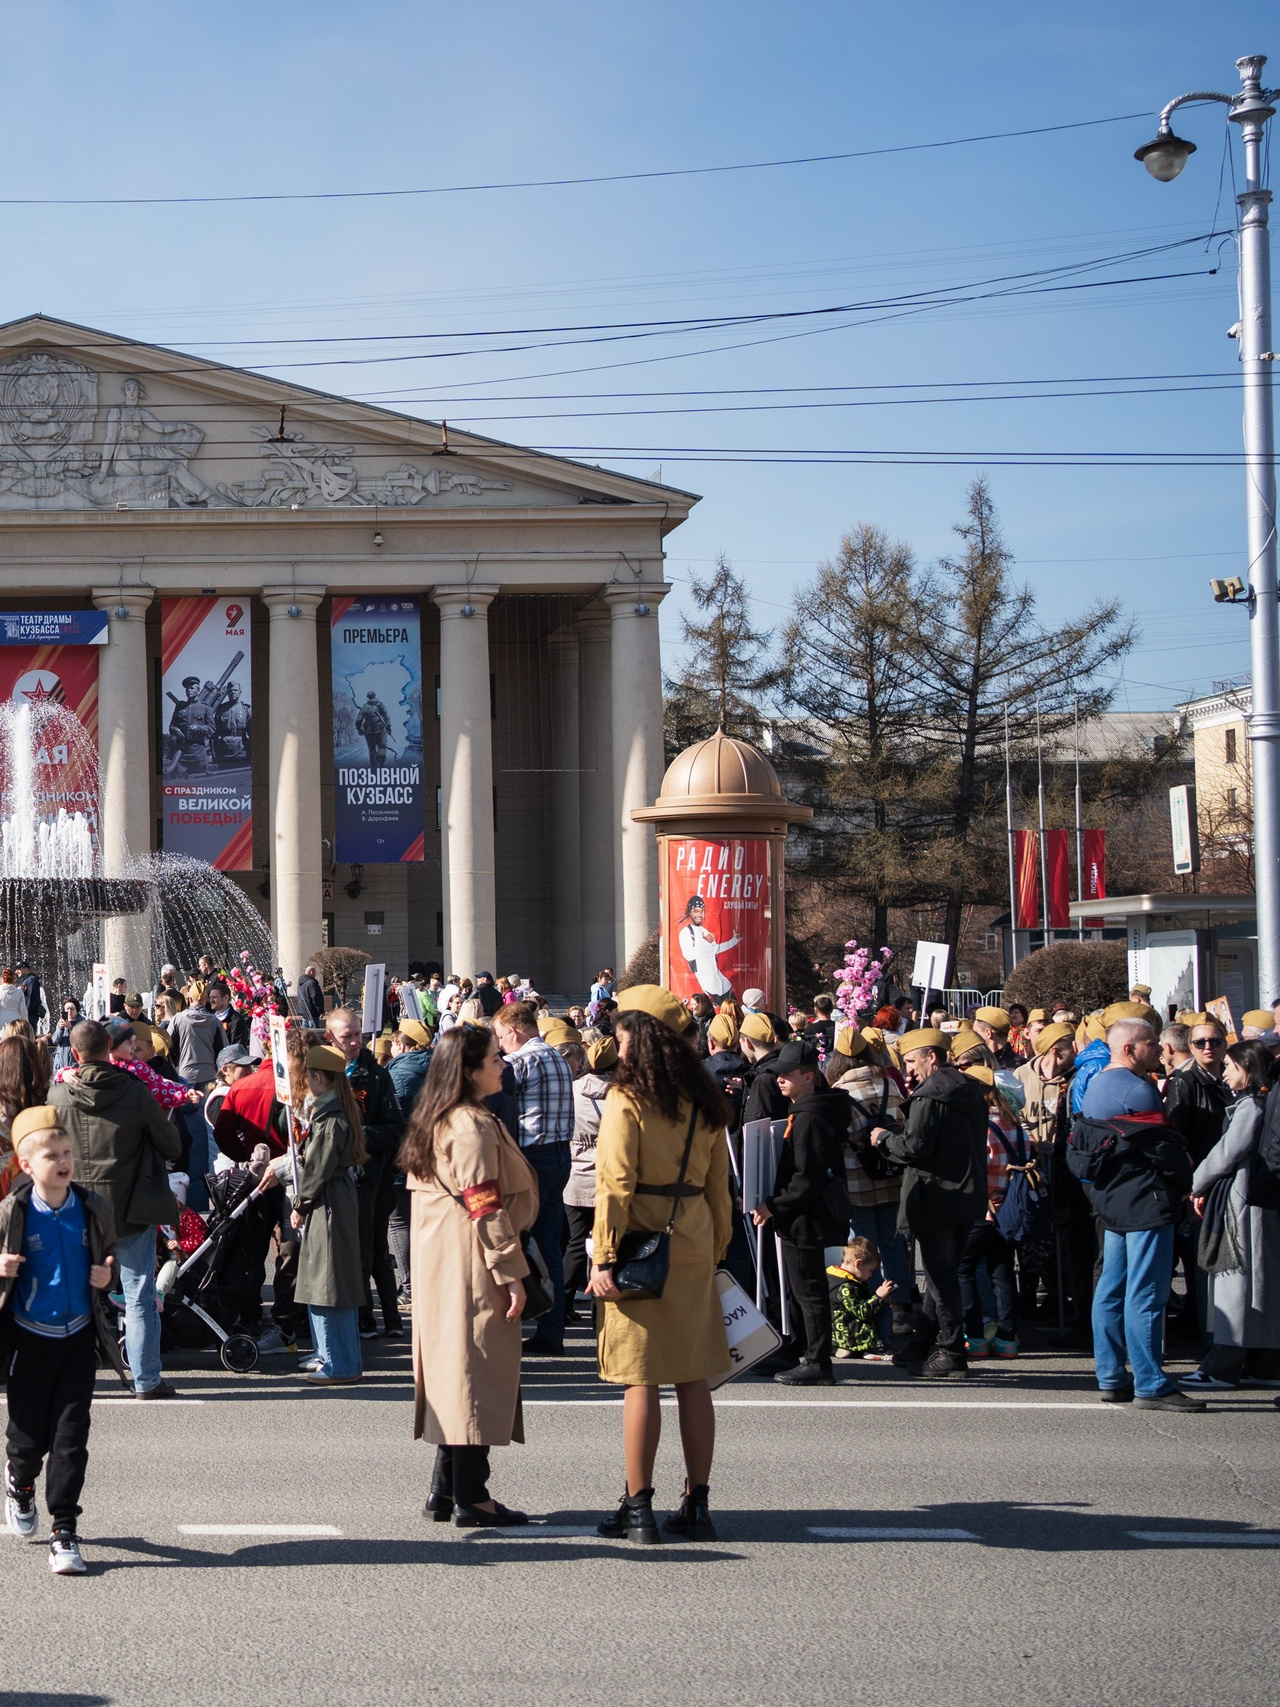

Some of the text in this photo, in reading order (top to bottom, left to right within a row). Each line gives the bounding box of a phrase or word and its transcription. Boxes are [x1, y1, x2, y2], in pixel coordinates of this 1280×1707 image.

[20, 615, 43, 625] ТЕАТР
[43, 614, 72, 625] ДРАМЫ
[225, 603, 244, 628] 9
[20, 625, 60, 634] КУЗБАССА
[343, 628, 409, 644] ПРЕМЬЕРА
[338, 763, 420, 786] ПОЗЫВНОЙ
[164, 787, 237, 796] С ПРАЗДНИКОМ
[346, 786, 413, 805] КУЗБАСС
[178, 794, 252, 811] ВЕЛИКОЙ
[170, 812, 243, 826] ПОБЕДЫ!
[676, 846, 745, 873] РАДИО
[696, 874, 763, 898] ENERGY
[1090, 862, 1099, 894] ПОБЕДА!
